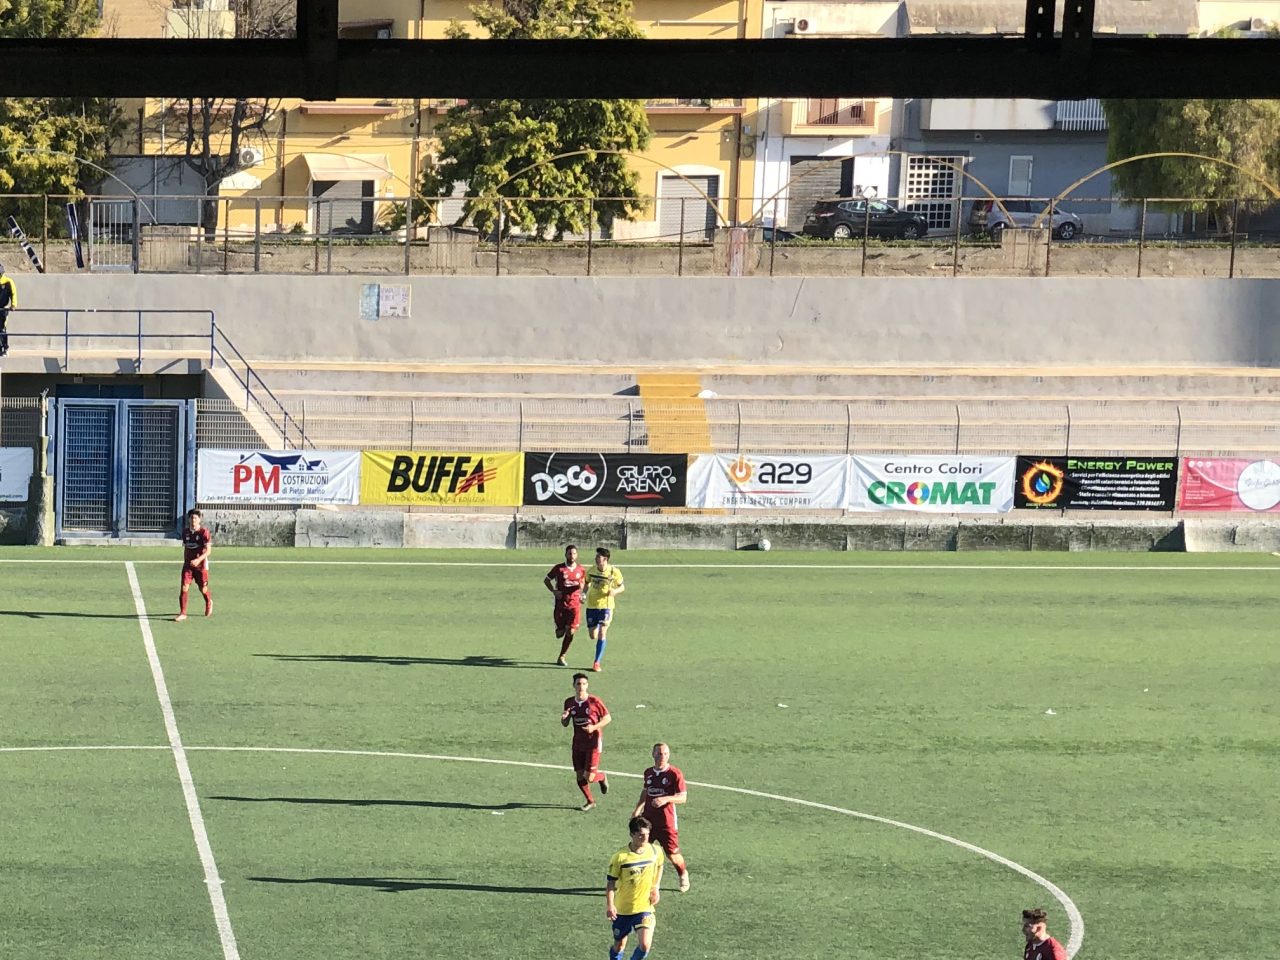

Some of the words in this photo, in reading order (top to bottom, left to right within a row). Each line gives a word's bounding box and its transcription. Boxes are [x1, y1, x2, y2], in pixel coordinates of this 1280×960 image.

[387, 455, 485, 493] BUFFA
[616, 466, 672, 479] GRUPPO
[758, 462, 813, 484] a29
[884, 463, 933, 474] Centro
[938, 462, 983, 474] Colori
[233, 465, 280, 494] PM
[283, 475, 329, 485] COSTRUZIONI
[616, 478, 671, 492] ARENA
[867, 480, 997, 505] CROMAT
[779, 497, 812, 506] COMPANY
